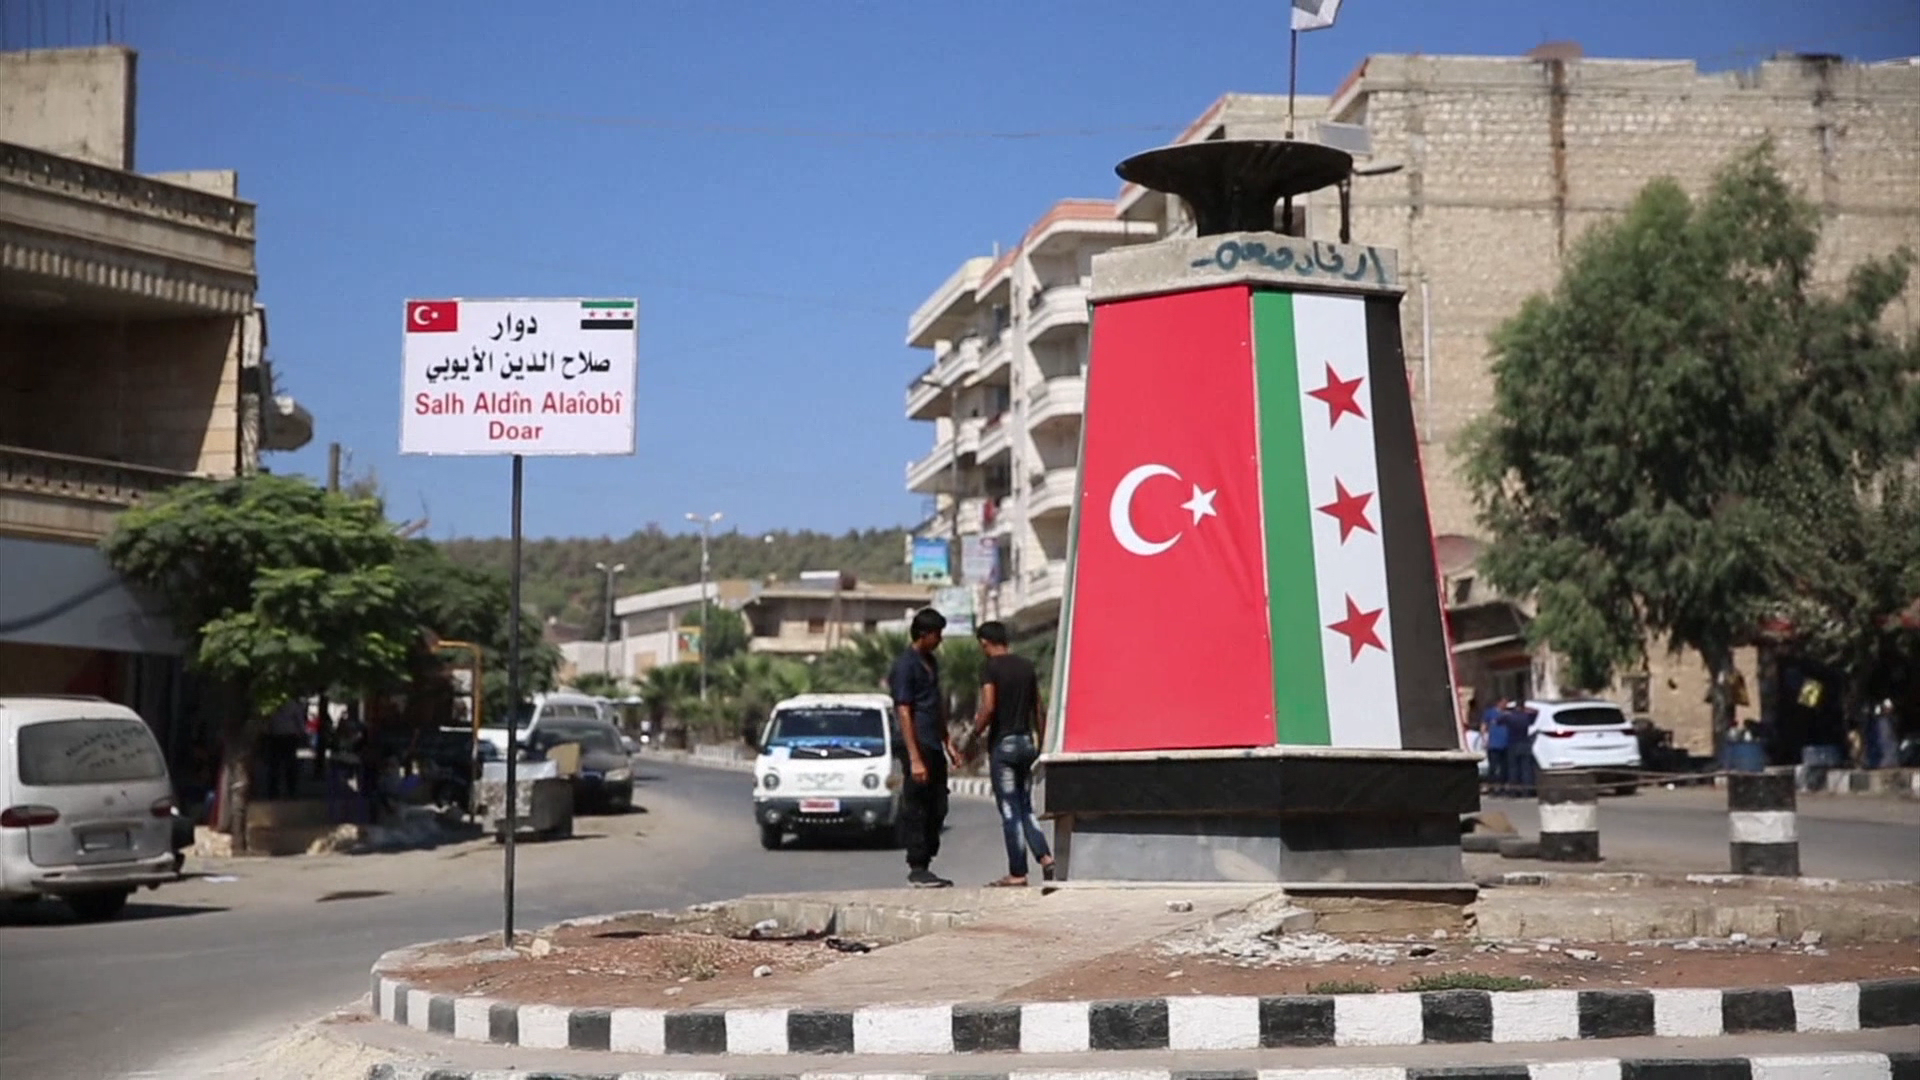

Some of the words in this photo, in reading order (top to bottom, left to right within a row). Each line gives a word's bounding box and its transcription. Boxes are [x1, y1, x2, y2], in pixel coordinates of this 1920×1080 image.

[490, 312, 538, 342] دوار
[425, 346, 494, 384] الأيوبي
[500, 350, 555, 380] الدين
[561, 350, 611, 380] صلاح
[415, 393, 465, 415] Salh
[473, 391, 532, 414] Aldîn
[541, 391, 622, 415] Alaîobî
[489, 420, 543, 440] Doar
